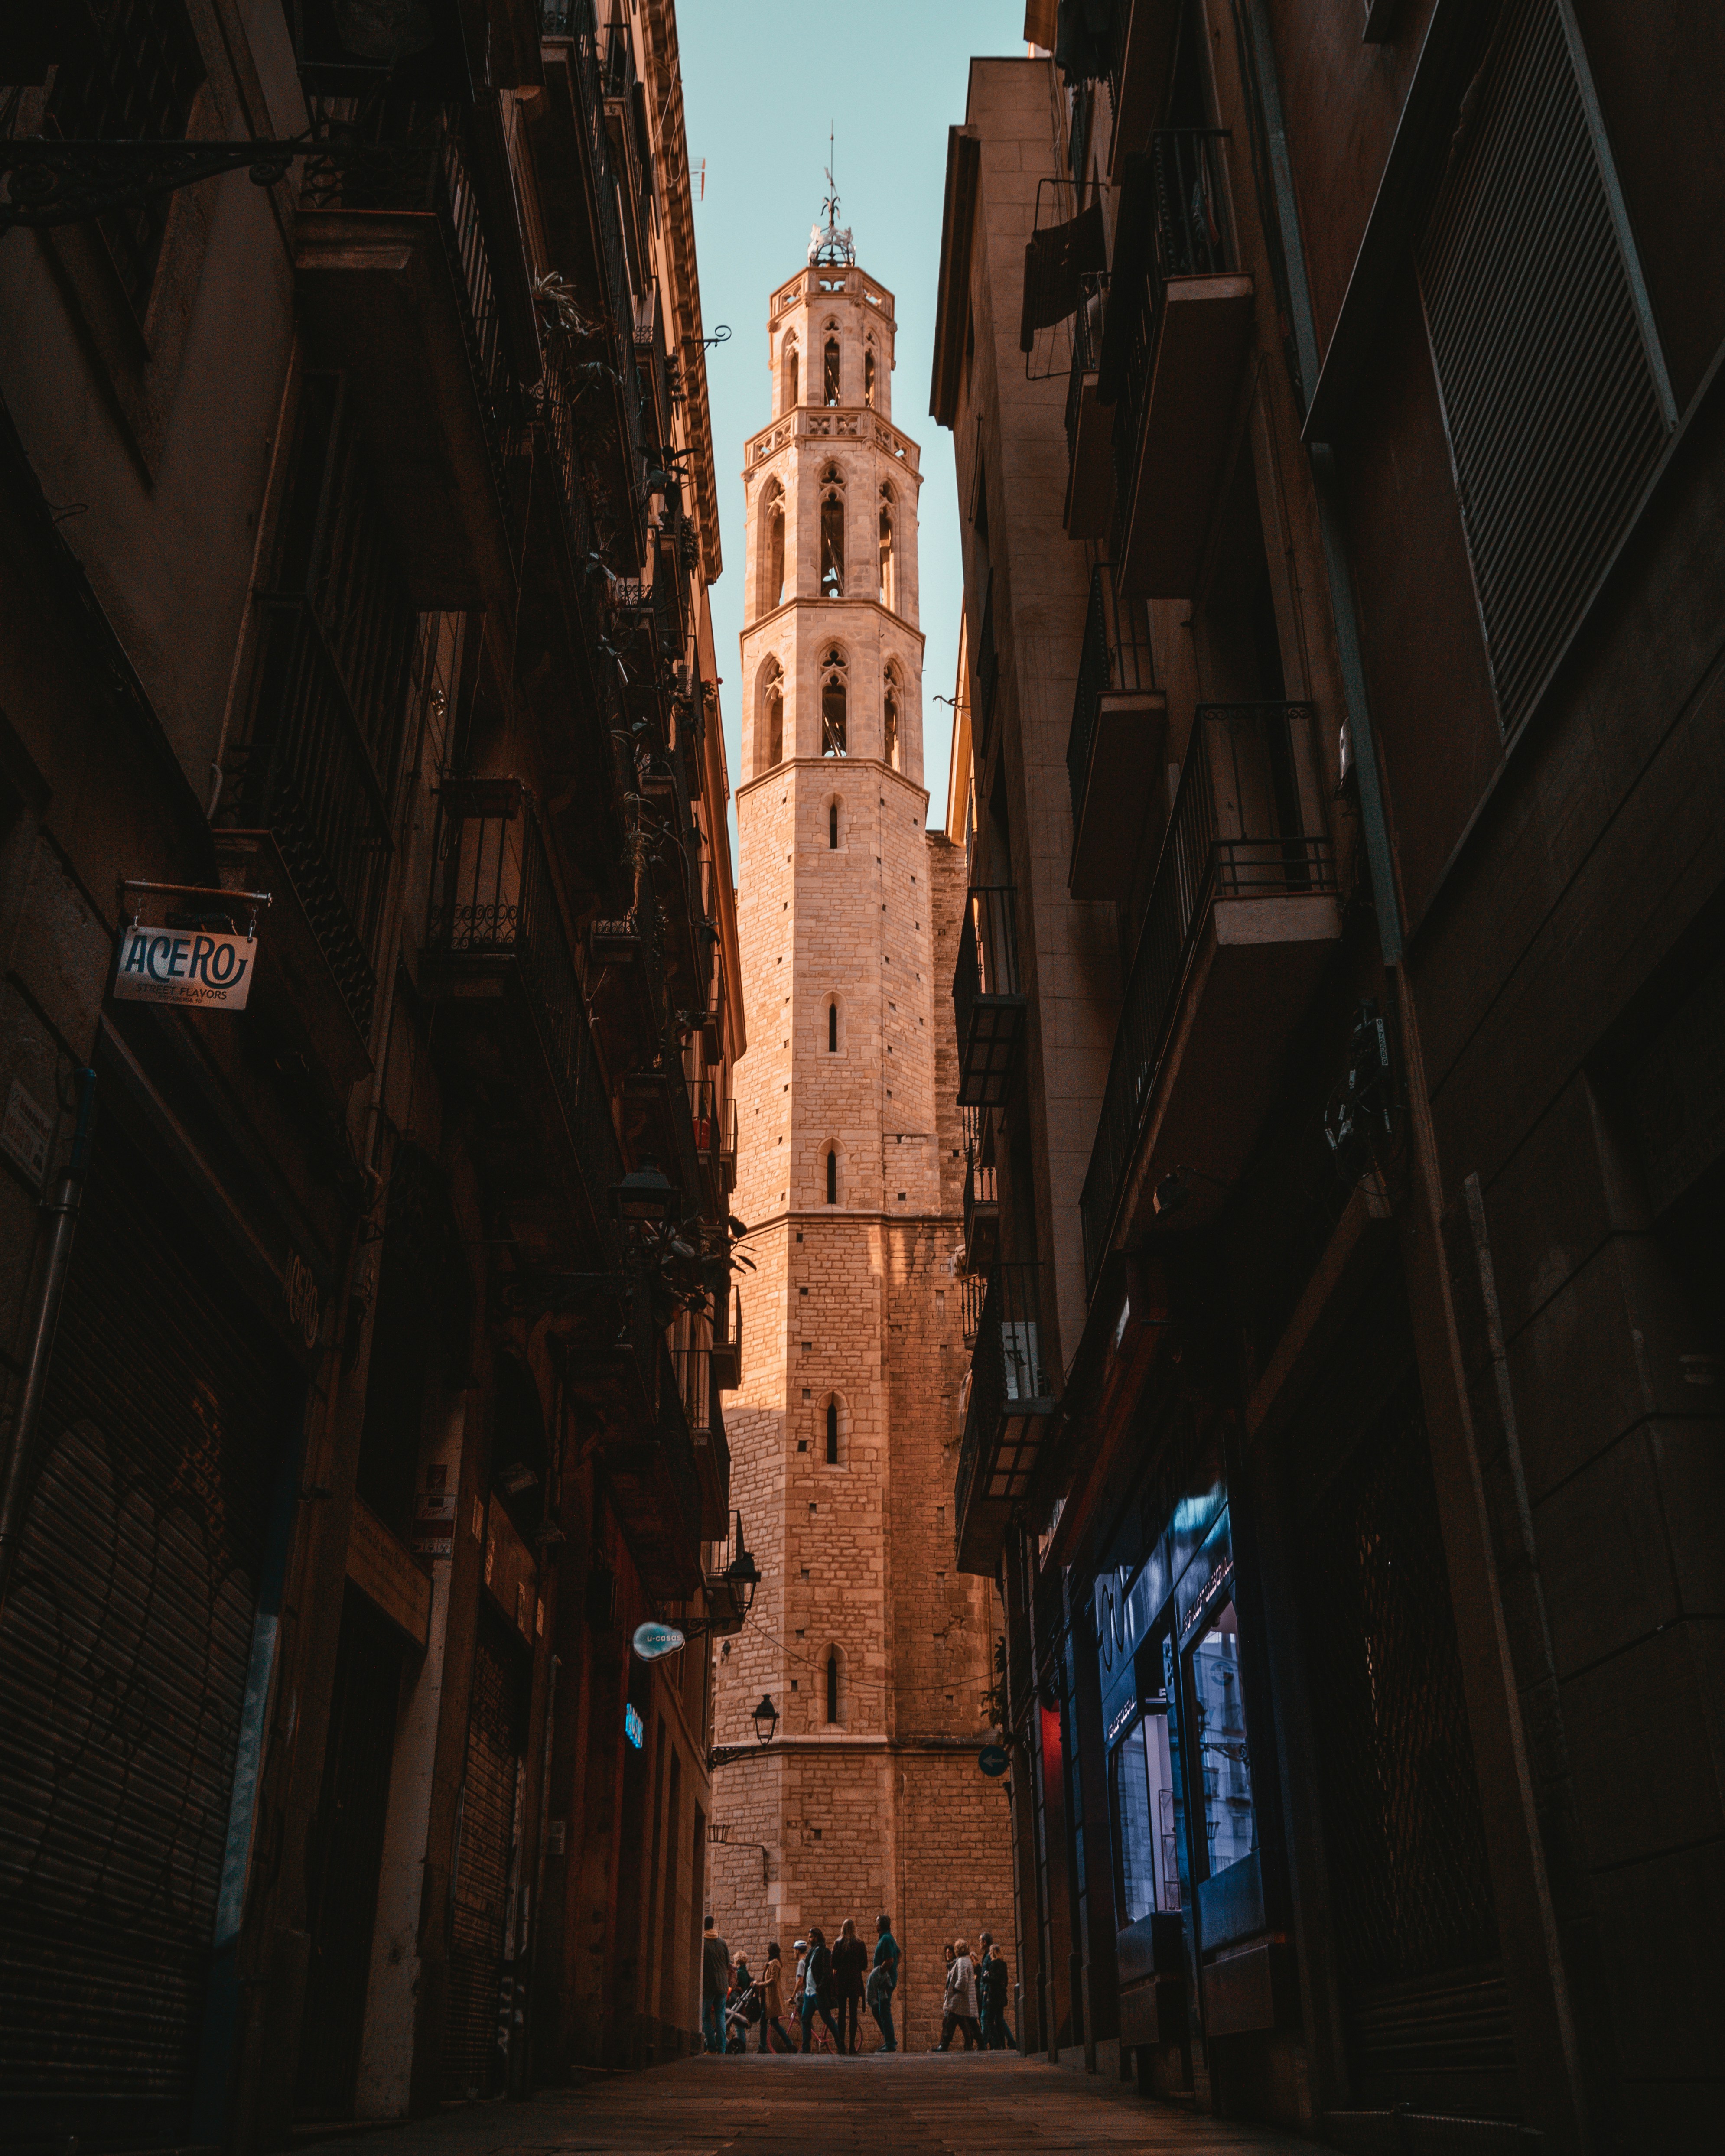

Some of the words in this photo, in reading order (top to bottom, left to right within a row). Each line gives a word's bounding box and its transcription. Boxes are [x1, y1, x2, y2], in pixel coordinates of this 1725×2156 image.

[124, 935, 249, 990] ACERO
[136, 983, 175, 994] STREET
[180, 987, 227, 1000] FLAVORS
